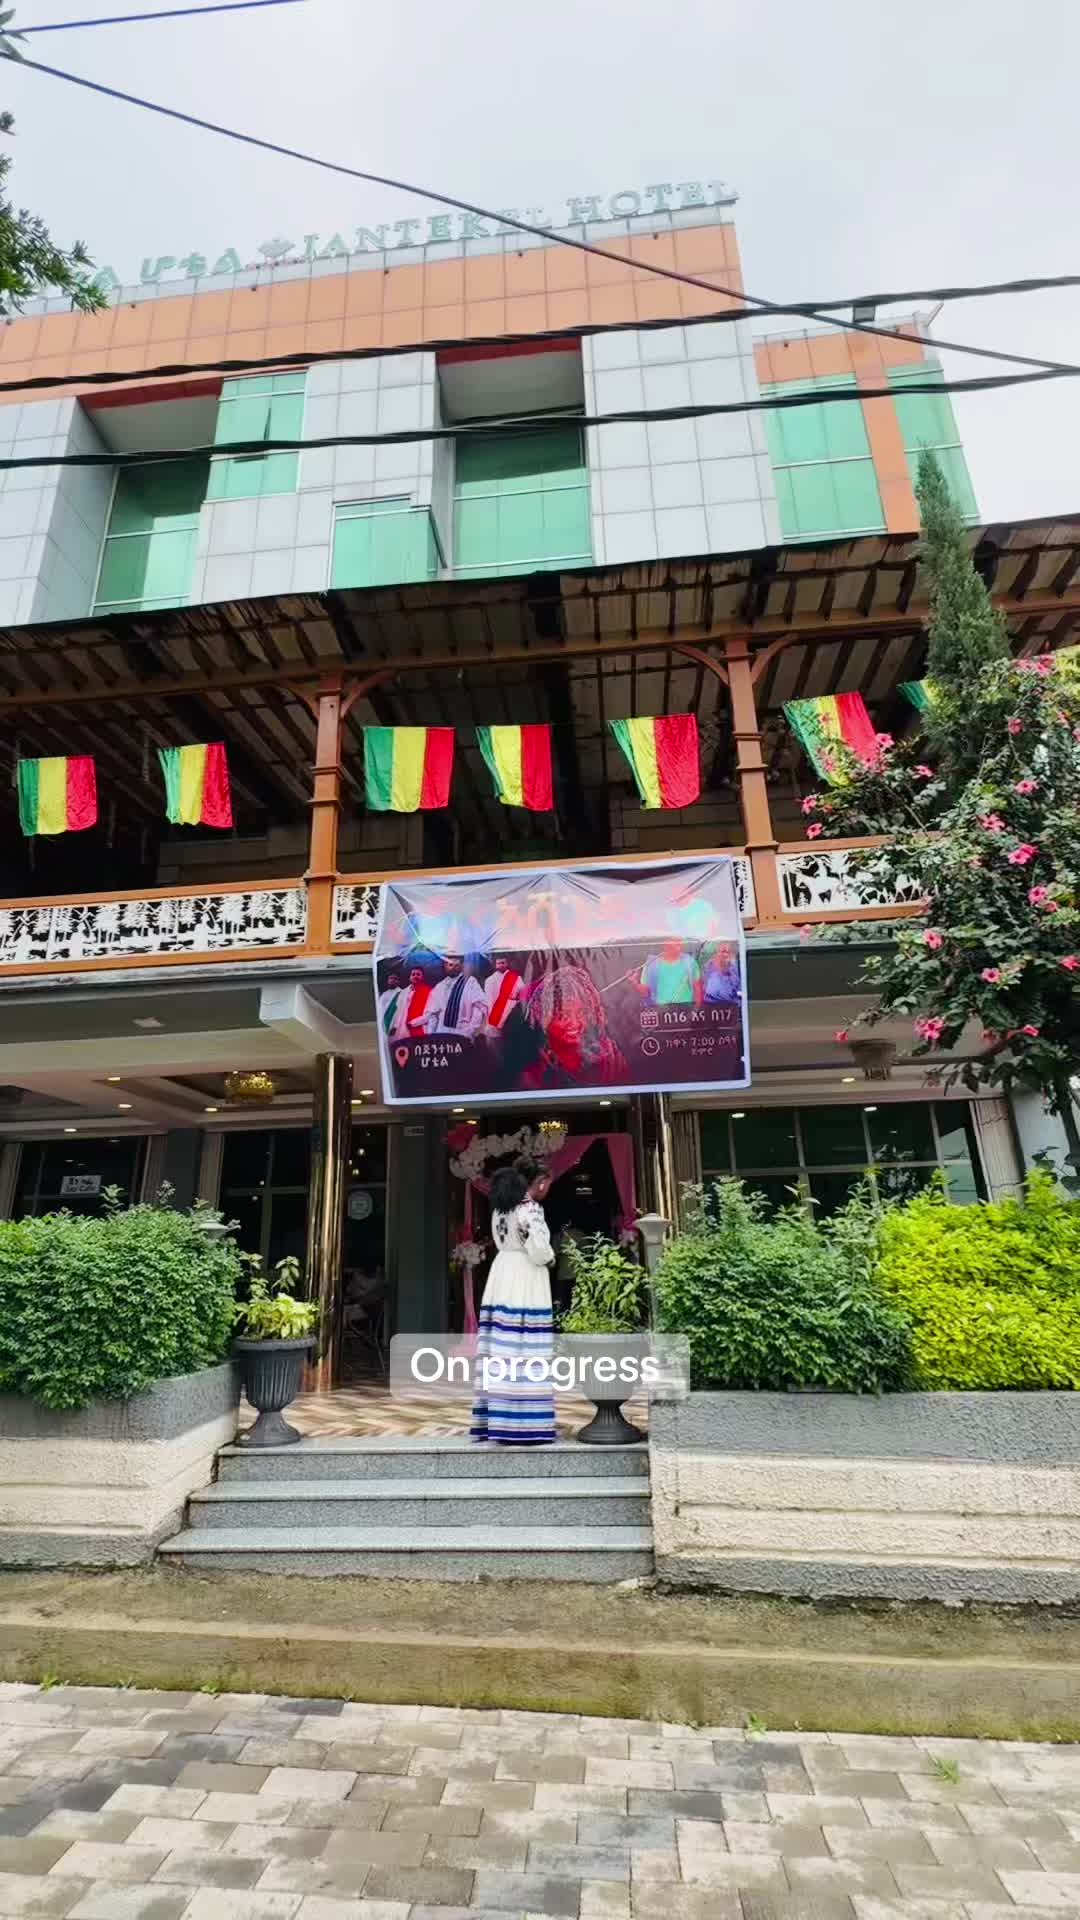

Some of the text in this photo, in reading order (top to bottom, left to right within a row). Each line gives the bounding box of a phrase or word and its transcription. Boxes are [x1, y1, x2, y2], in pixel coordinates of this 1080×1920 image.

[563, 180, 737, 224] HOTEL
[664, 1010, 687, 1023] በ16
[711, 1009, 731, 1021] በ17
[691, 1036, 715, 1046] 7:00
[420, 1056, 449, 1068] ሆቴል
